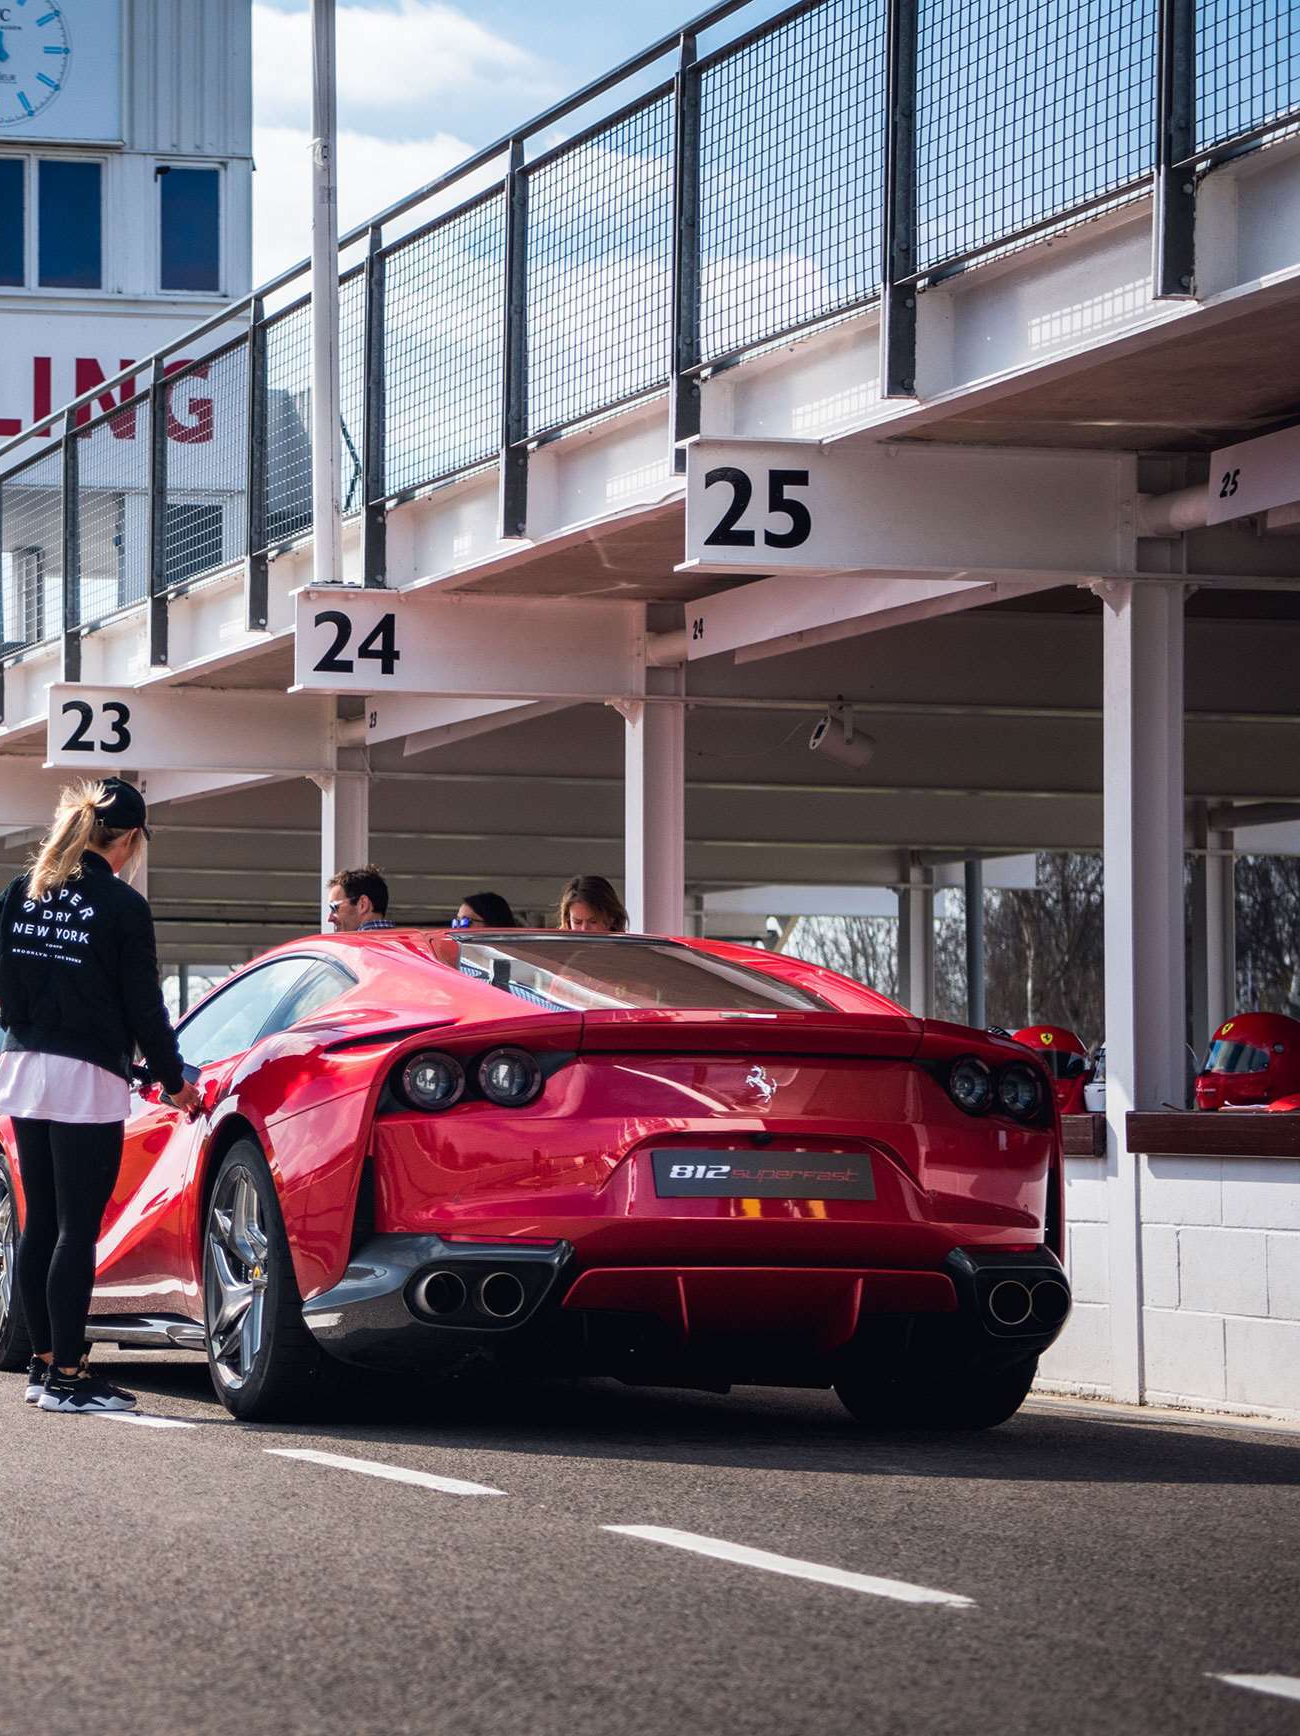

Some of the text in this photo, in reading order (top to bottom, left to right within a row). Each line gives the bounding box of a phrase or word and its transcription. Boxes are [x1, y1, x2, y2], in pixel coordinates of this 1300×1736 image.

[1219, 468, 1241, 498] 25
[703, 466, 812, 549] 25
[313, 610, 401, 675] 24
[692, 617, 704, 640] 24
[61, 700, 132, 753] 23
[23, 889, 95, 920] SUPER
[42, 910, 72, 922] DRY
[12, 922, 90, 944] NEW YORK
[669, 1165, 859, 1184] 812 superfast
